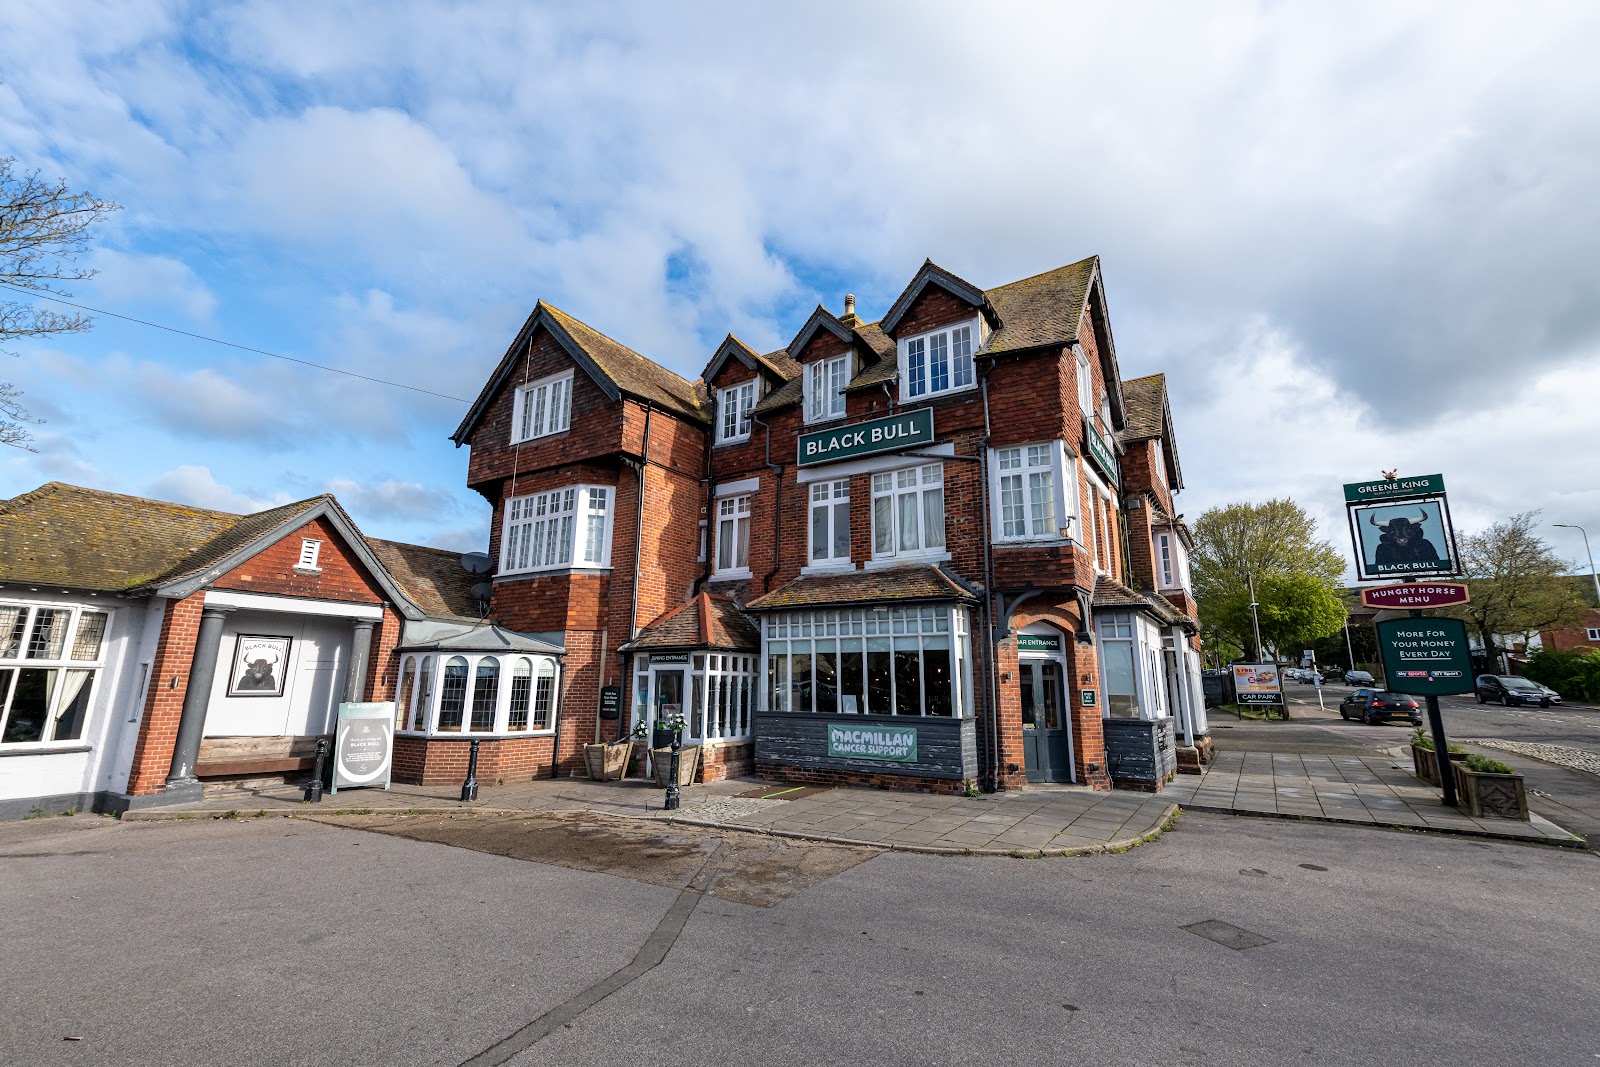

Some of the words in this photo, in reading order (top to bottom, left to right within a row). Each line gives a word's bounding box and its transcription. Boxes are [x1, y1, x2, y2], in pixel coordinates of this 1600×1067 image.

[806, 431, 866, 456] BLACK
[871, 421, 921, 443] BULL
[1358, 483, 1399, 494] GREENE
[1401, 479, 1430, 489] KING
[1377, 563, 1410, 571] BLACK
[1412, 561, 1438, 569] BULL
[1372, 587, 1416, 598] HUNGRY
[1418, 587, 1456, 595] HORSE
[245, 643, 266, 651] BLACK
[268, 644, 282, 652] BULL
[1400, 650, 1428, 658] EVERY
[831, 729, 914, 747] MACMILLAN
[832, 742, 867, 753] CANCER
[867, 745, 909, 756] SUPPORT
